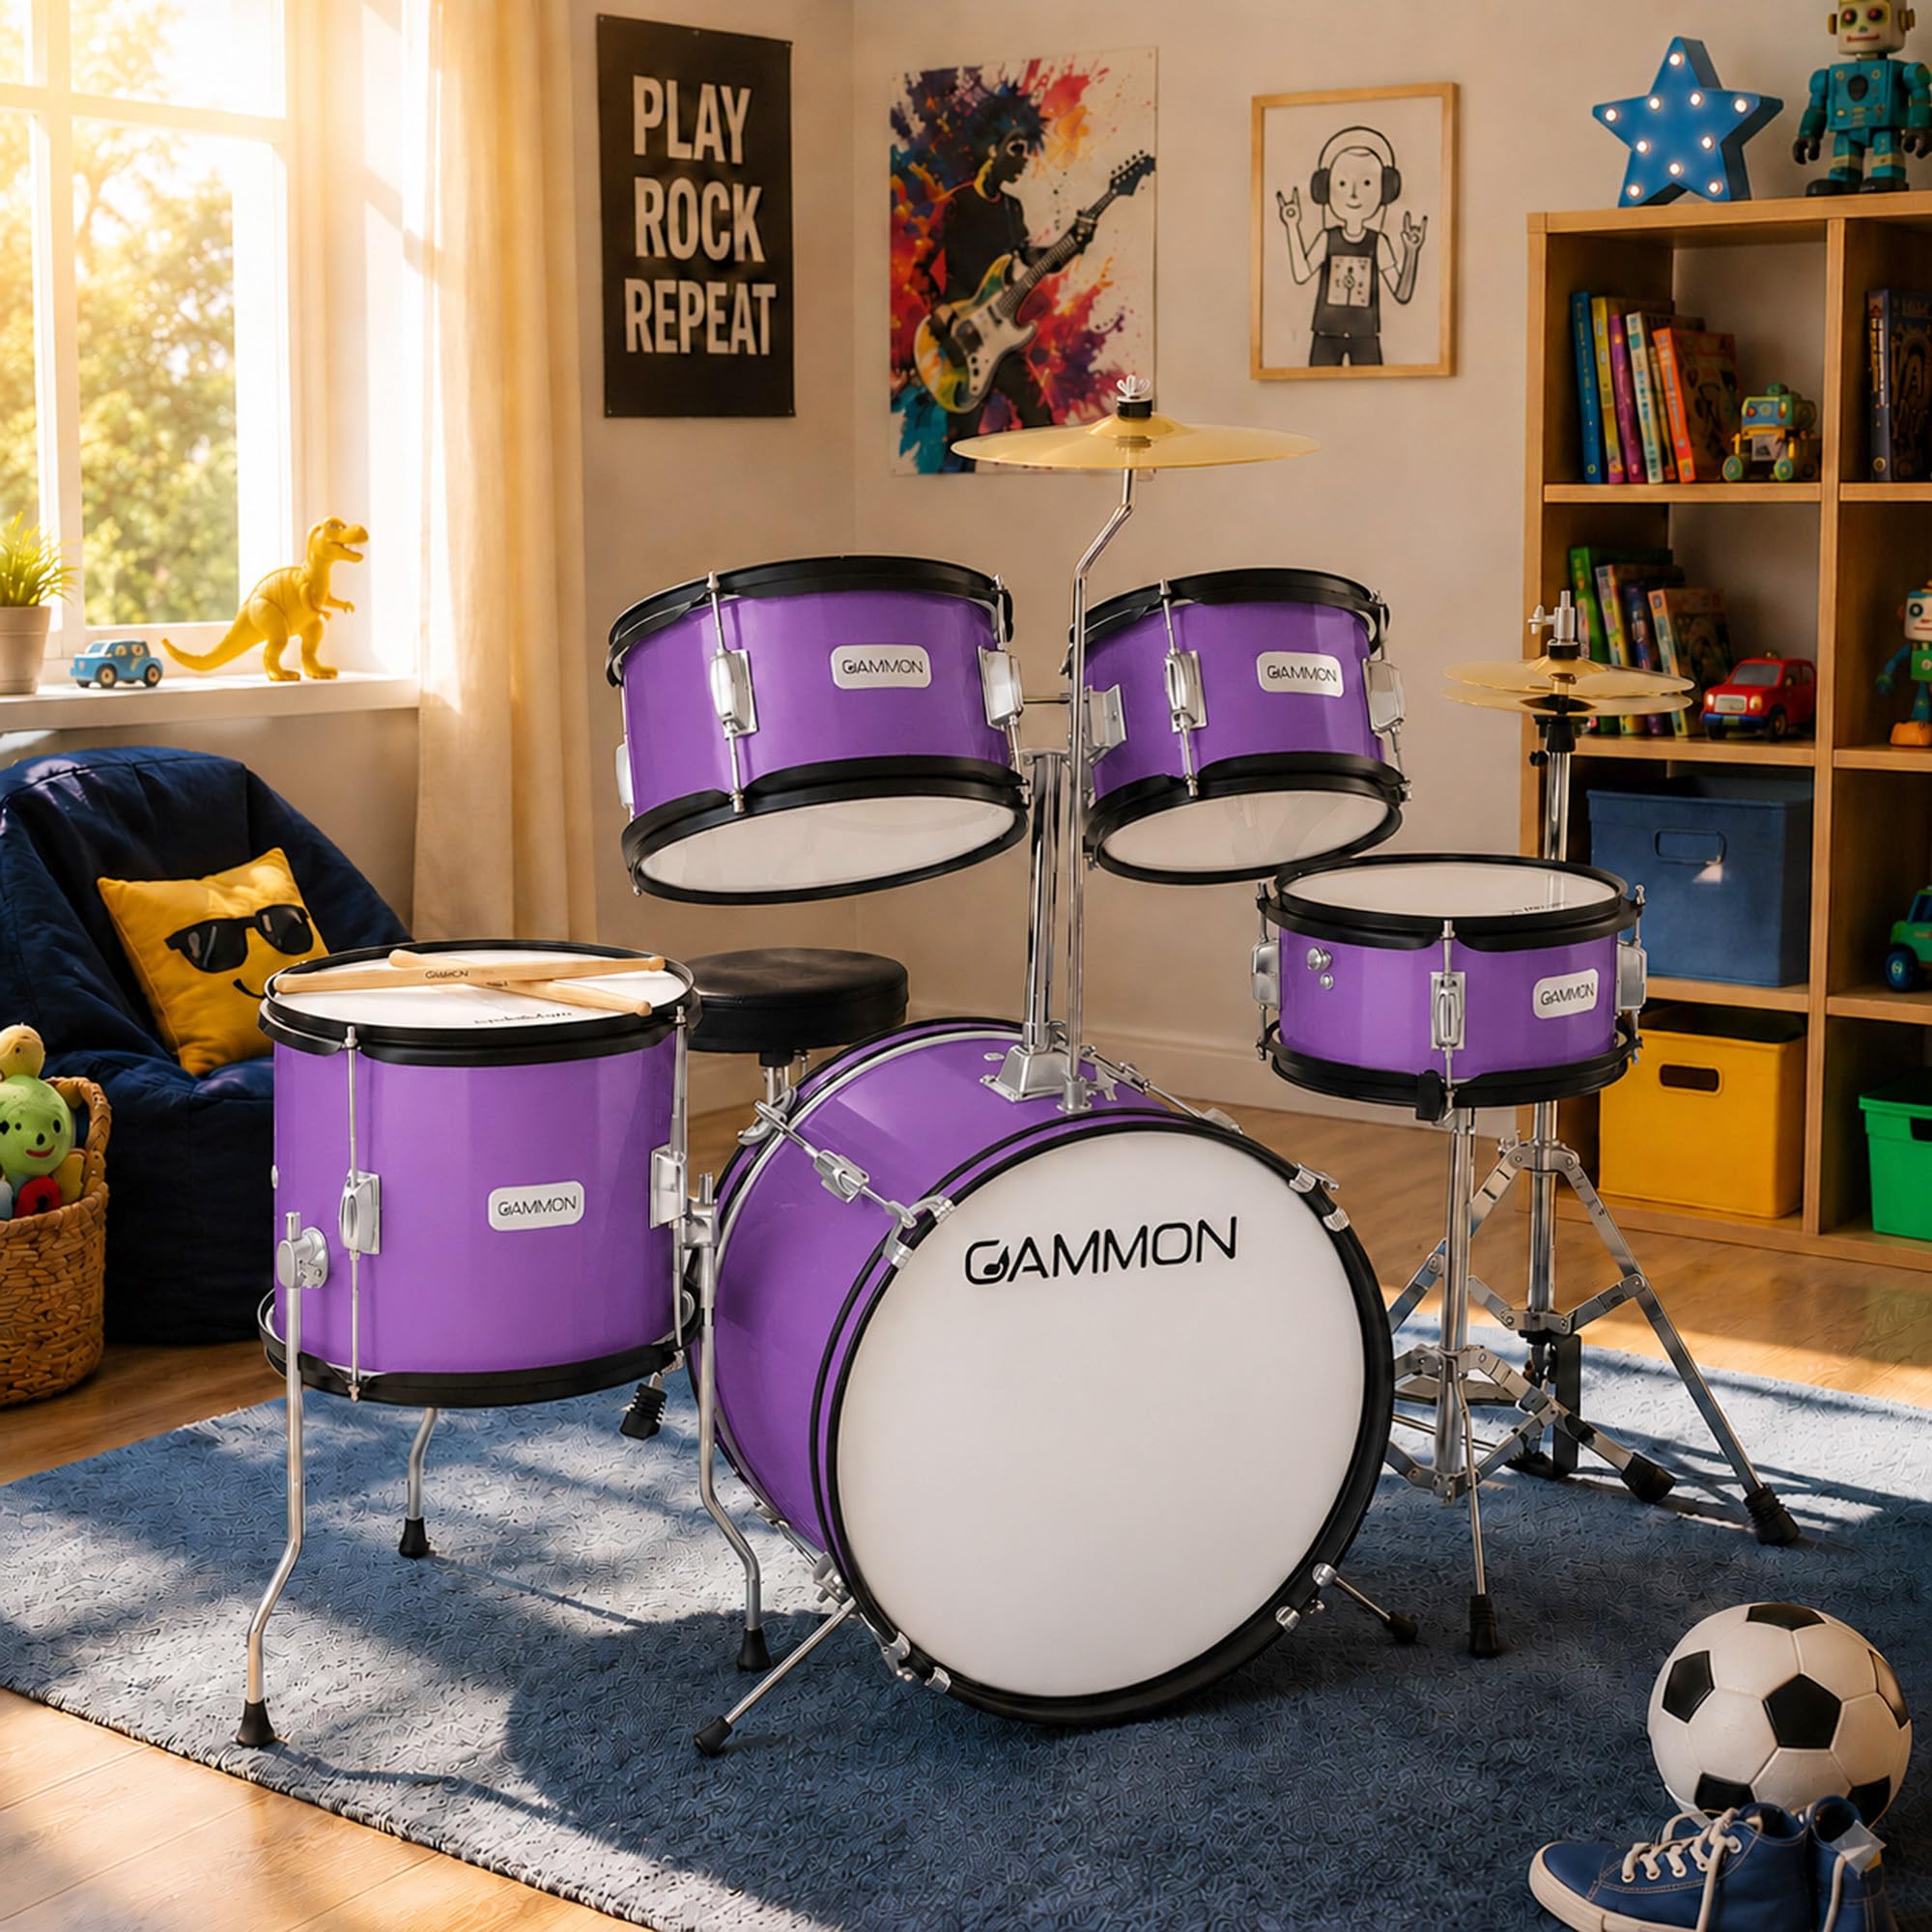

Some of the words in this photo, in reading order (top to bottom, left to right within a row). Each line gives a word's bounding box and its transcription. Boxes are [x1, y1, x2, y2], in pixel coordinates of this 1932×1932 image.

[633, 74, 752, 164] PLAY
[634, 176, 766, 263] ROCK
[624, 277, 777, 355] REPEAT
[841, 659, 923, 674] GAMMON
[1266, 665, 1337, 682] GAMMON
[1540, 982, 1595, 1006] GAMMON
[497, 1195, 577, 1216] GAMMON
[965, 1216, 1237, 1286] GAMMON
